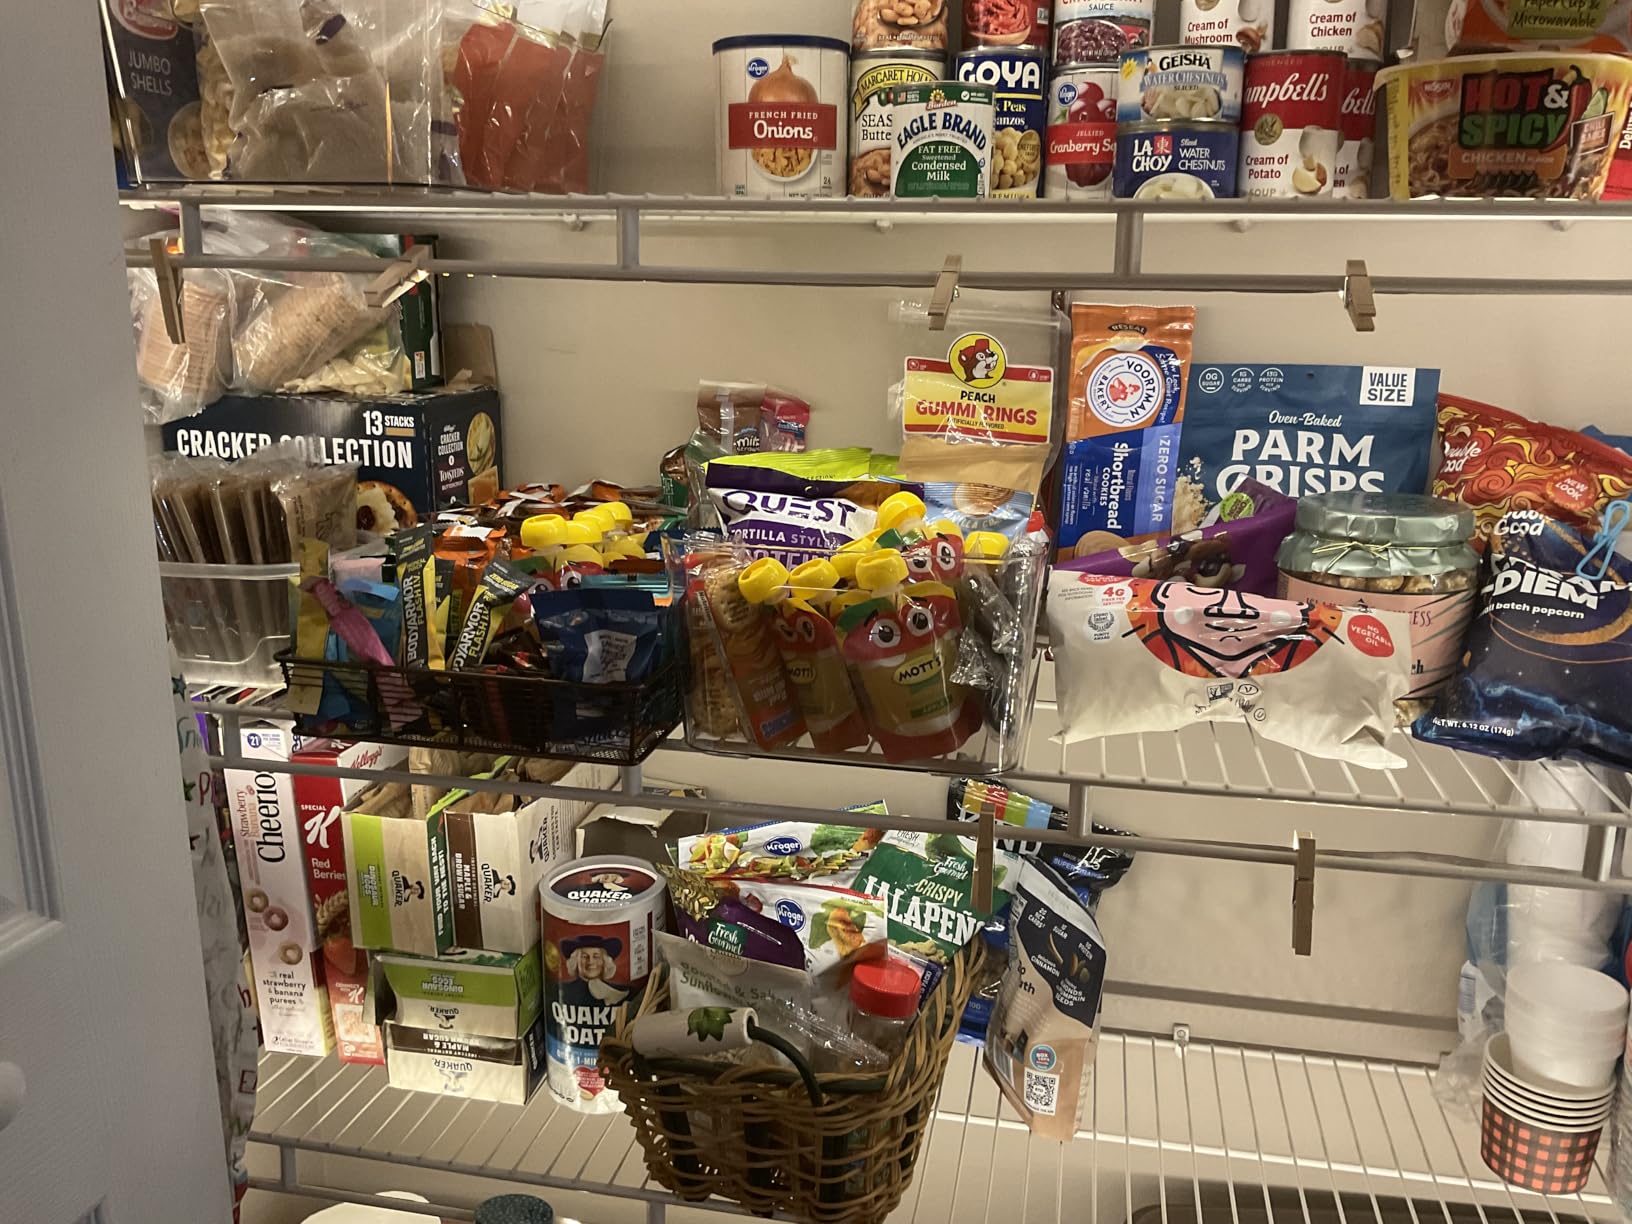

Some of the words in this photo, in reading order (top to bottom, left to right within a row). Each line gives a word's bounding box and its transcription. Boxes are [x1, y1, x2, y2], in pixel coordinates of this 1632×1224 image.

[1088, 3, 1115, 11] SAUCE
[1187, 20, 1216, 32] Cream
[1217, 18, 1229, 30] of
[1309, 13, 1344, 25] Cream
[1345, 12, 1357, 23] of
[1512, 11, 1597, 28] Microwavable
[1184, 33, 1233, 45] Mushroom
[1310, 26, 1353, 38] Chicken
[127, 50, 172, 77] JUMBO
[1158, 53, 1213, 71] GEISHA
[860, 69, 905, 93] MARGARET
[958, 60, 1041, 90] GOYA
[1143, 74, 1175, 88] WATER
[1175, 71, 1226, 89] CHESTNUTS
[129, 74, 173, 98] SHELLS
[1464, 76, 1549, 112] HOT
[926, 98, 958, 110] Borden
[1543, 83, 1570, 109] &
[748, 111, 788, 119] FRENCH
[791, 111, 819, 119] FRIED
[1002, 99, 1027, 113] Peas
[753, 119, 814, 140] Onions
[896, 111, 938, 151] EAGLE
[941, 111, 987, 151] BRAND
[1075, 129, 1105, 137] JELLIED
[1461, 113, 1569, 146] SPICY
[917, 145, 936, 154] FAT
[938, 145, 961, 154] FREE
[1050, 139, 1100, 156] Cranberry
[1132, 138, 1154, 157] LA
[1179, 147, 1211, 159] WATER
[911, 160, 967, 171] Condensed
[921, 153, 957, 162] Sweetened
[1131, 154, 1173, 173] CHOY
[1178, 160, 1226, 171] CHESTNUTS
[1245, 155, 1276, 166] Cream
[1277, 153, 1289, 166] of
[1460, 151, 1527, 164] CHICKEN
[926, 170, 951, 182] Milk
[1248, 169, 1282, 180] Potato
[1249, 187, 1277, 198] SOUP
[1125, 359, 1156, 419] VOORTMAN
[1369, 372, 1408, 388] VALUE
[960, 390, 996, 404] PEACH
[1095, 374, 1112, 412] BAKERY
[1367, 388, 1407, 403] SIZE
[915, 399, 977, 419] GUMMI
[983, 406, 1038, 426] RINGS
[1267, 410, 1343, 428] Oven-Baked
[363, 409, 384, 437] 13
[384, 414, 415, 428] STACKS
[176, 428, 271, 458] CRACKER
[280, 434, 413, 470] COLLECTION
[1230, 428, 1375, 467] PARM
[1156, 439, 1171, 476] ZERO
[1099, 466, 1111, 507] COOKIES
[1107, 442, 1129, 530] Shortbread
[1555, 481, 1583, 501] LOOK
[1562, 477, 1589, 492] NEW
[1082, 486, 1091, 510] vanilla
[1151, 477, 1167, 523] SUGAR
[722, 489, 858, 528] QUEST
[1493, 518, 1545, 537] Good
[1103, 586, 1126, 598] 4G
[415, 589, 425, 625] FLASH
[1495, 601, 1531, 612] batch
[1531, 605, 1586, 620] popcorn
[402, 574, 418, 662] BODYARMOR
[1350, 624, 1392, 648] VEGETABLE
[1366, 624, 1380, 634] NO
[468, 620, 488, 658] FLASH
[1364, 637, 1379, 647] OIL
[1478, 724, 1490, 733] OZ
[1490, 726, 1514, 737] (174g)
[249, 736, 261, 747] 21
[350, 745, 385, 769] Kellogg's
[236, 789, 249, 838] Strawberry
[247, 801, 260, 839] Banana
[303, 805, 342, 849] K
[541, 816, 550, 863] QUAKER
[766, 840, 801, 854] Kroger
[312, 858, 331, 869] Red
[454, 852, 465, 882] BROWN
[933, 861, 969, 881] Gourmet
[943, 855, 968, 873] Fresh
[367, 864, 379, 907] DINOSAUR
[462, 864, 472, 892] MAPLE
[481, 863, 493, 904] QUAKER
[391, 869, 404, 908] QUAKER
[455, 883, 466, 910] SUGAR
[567, 889, 634, 902] QUAKER
[915, 878, 964, 908] CRISPY
[778, 906, 805, 926] Kroger
[715, 922, 739, 944] Fresh
[707, 930, 744, 956] Gourmet
[278, 971, 295, 979] real
[1030, 955, 1060, 977] CINNAMON
[262, 979, 307, 991] strawberry
[273, 988, 304, 998] banana
[422, 982, 464, 993] DINOSAUR
[269, 996, 297, 1006] purees
[429, 1005, 460, 1015] QUAKER
[441, 1041, 469, 1051] MAPLE
[433, 1057, 473, 1072] QUAKER
